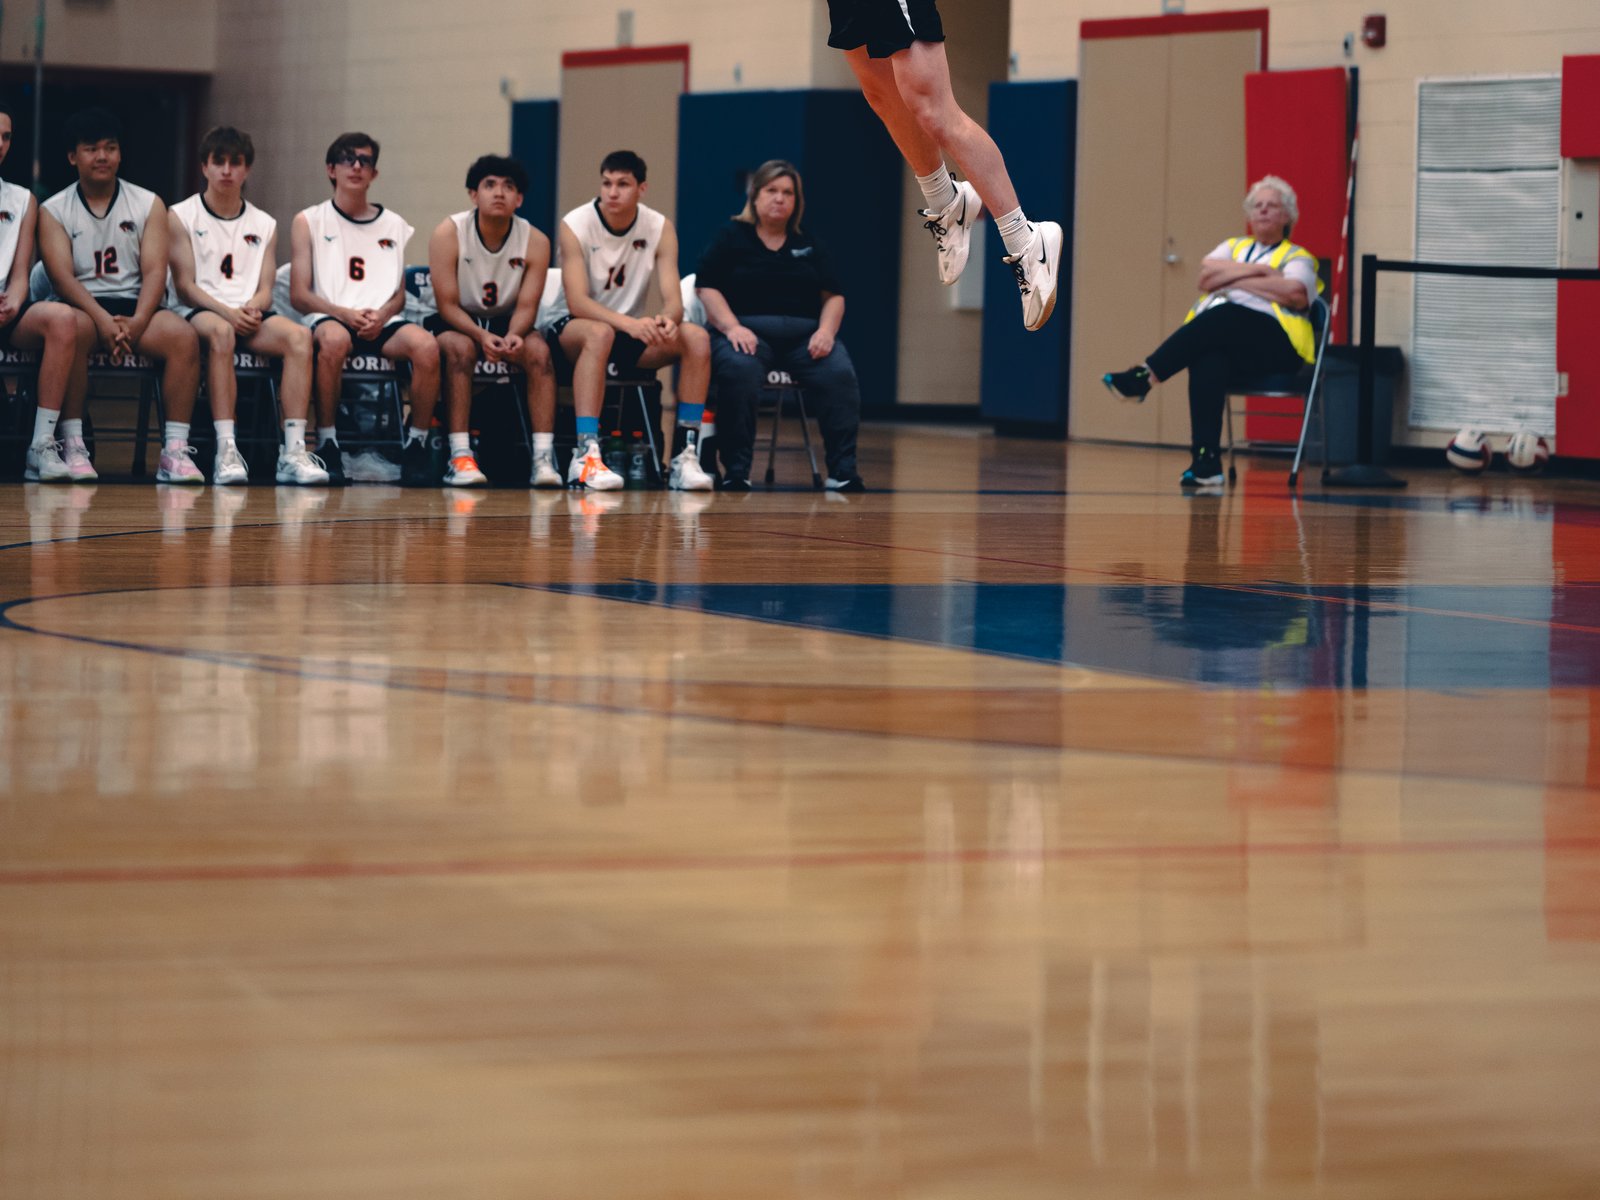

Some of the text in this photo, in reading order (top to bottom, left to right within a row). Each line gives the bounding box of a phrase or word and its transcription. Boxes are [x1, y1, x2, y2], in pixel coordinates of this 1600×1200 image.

[94, 246, 119, 277] 12
[220, 254, 233, 279] 4
[349, 256, 365, 281] 6
[604, 264, 625, 290] 14
[482, 281, 498, 307] 3
